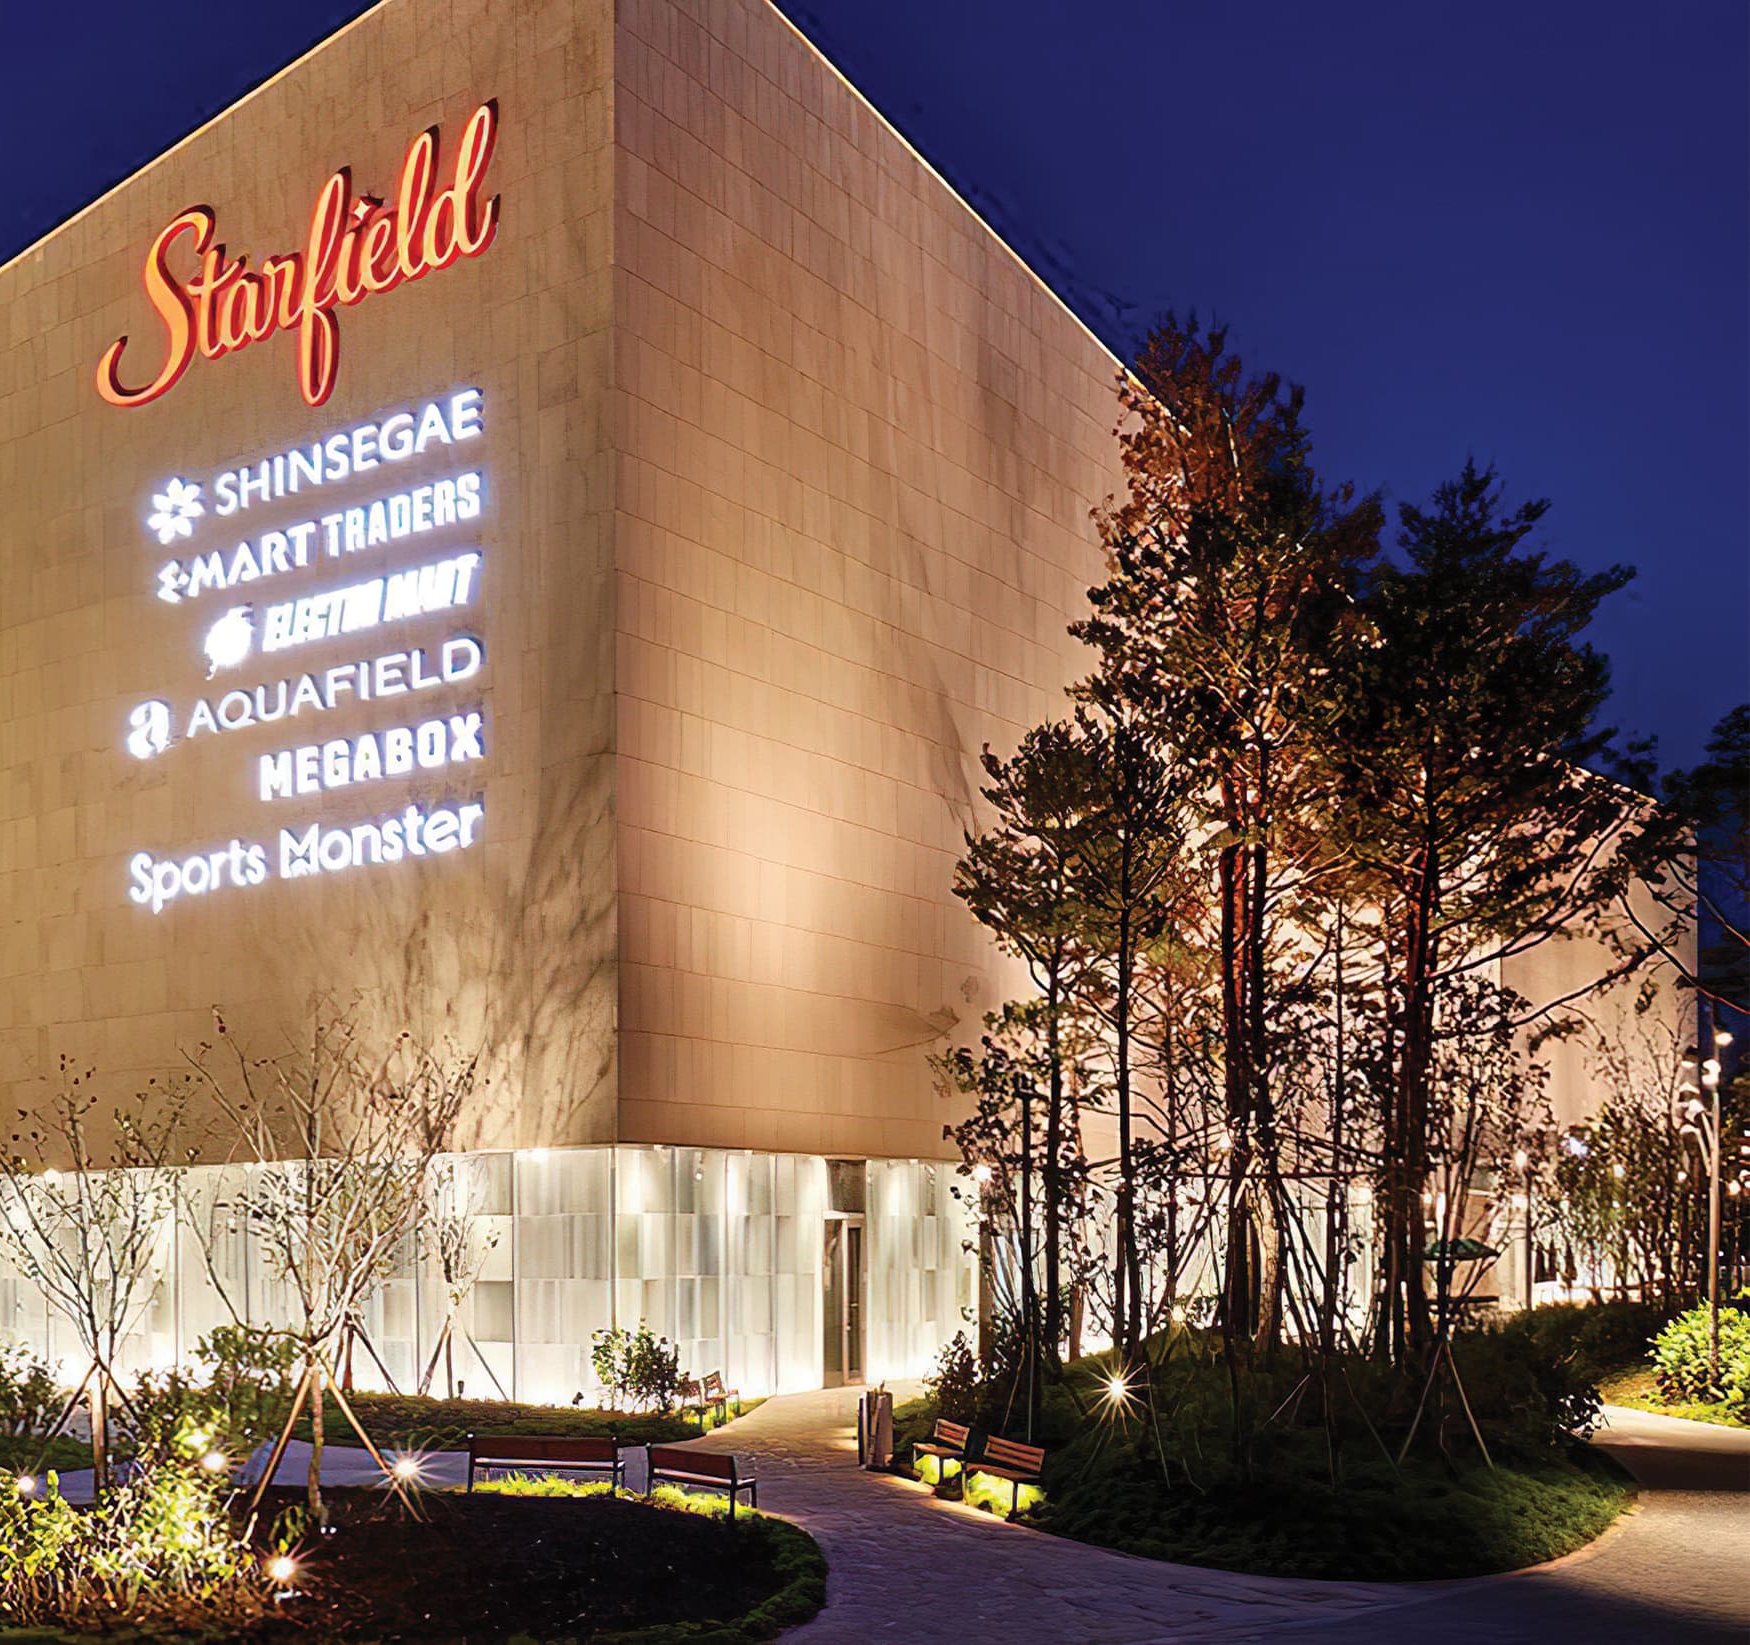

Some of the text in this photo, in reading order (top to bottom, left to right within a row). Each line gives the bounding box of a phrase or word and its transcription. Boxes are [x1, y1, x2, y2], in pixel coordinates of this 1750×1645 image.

[97, 98, 500, 407] Starfield
[215, 388, 483, 515] SHINSEGAE
[320, 472, 481, 557] TRADERS
[262, 579, 383, 652] ELECT
[186, 637, 484, 738] AQUAFIELD
[259, 713, 484, 801] MEGABOX
[128, 802, 484, 914] Sports Monster
